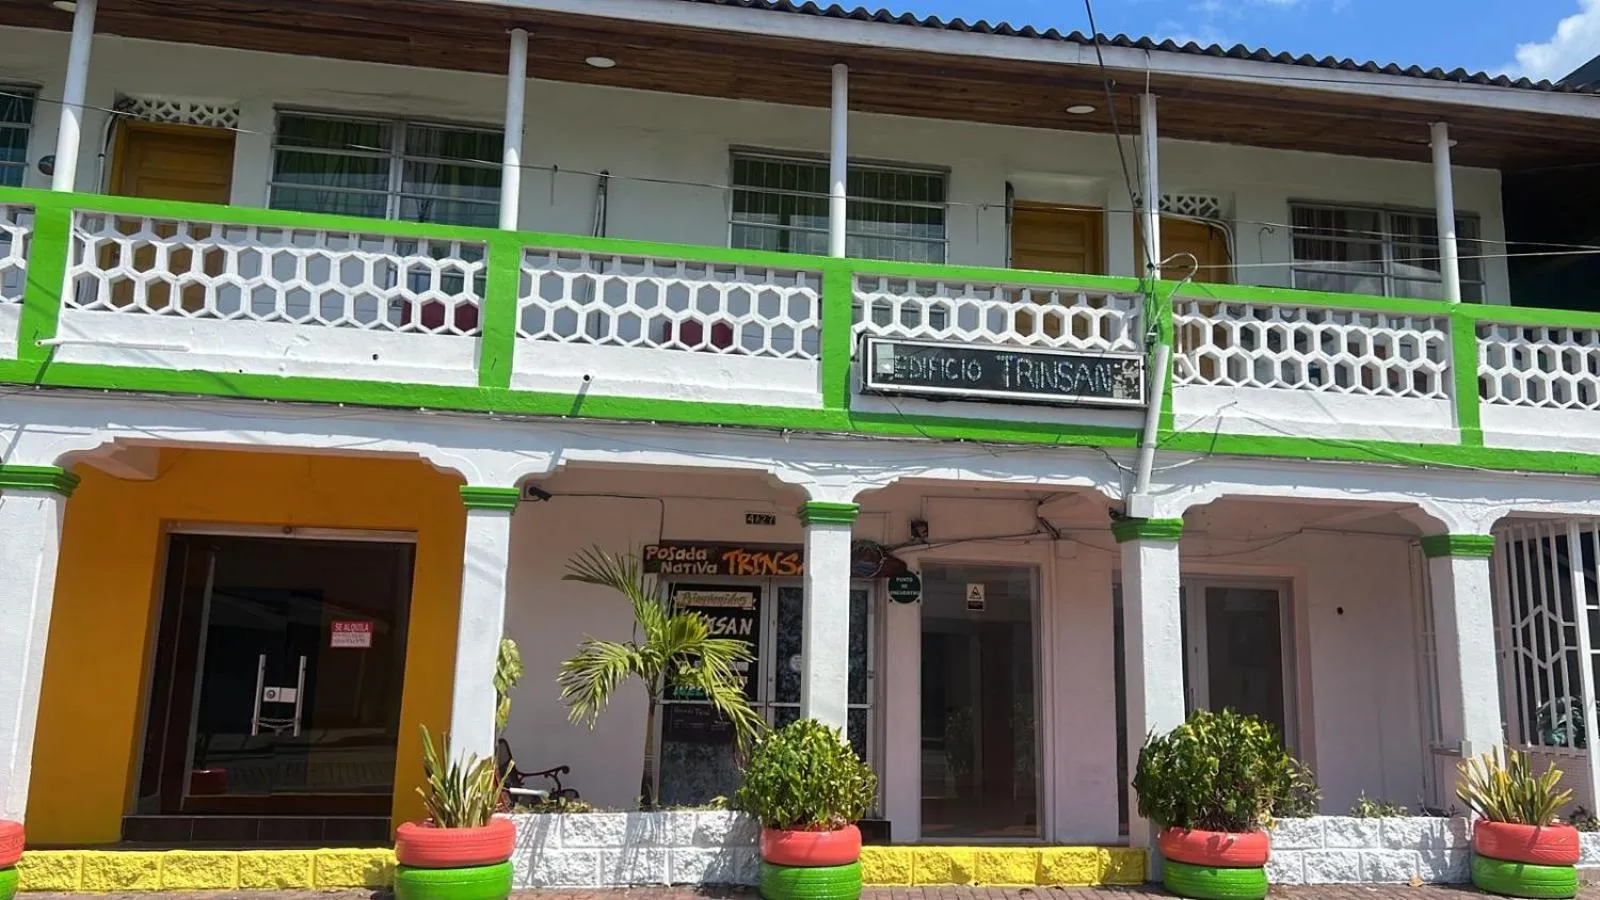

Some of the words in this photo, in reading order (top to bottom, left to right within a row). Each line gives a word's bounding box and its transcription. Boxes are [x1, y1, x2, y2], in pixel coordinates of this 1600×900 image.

[895, 354, 982, 381] EDIFICIO
[996, 354, 1113, 393] TRINSAN
[722, 550, 804, 575] TRINS
